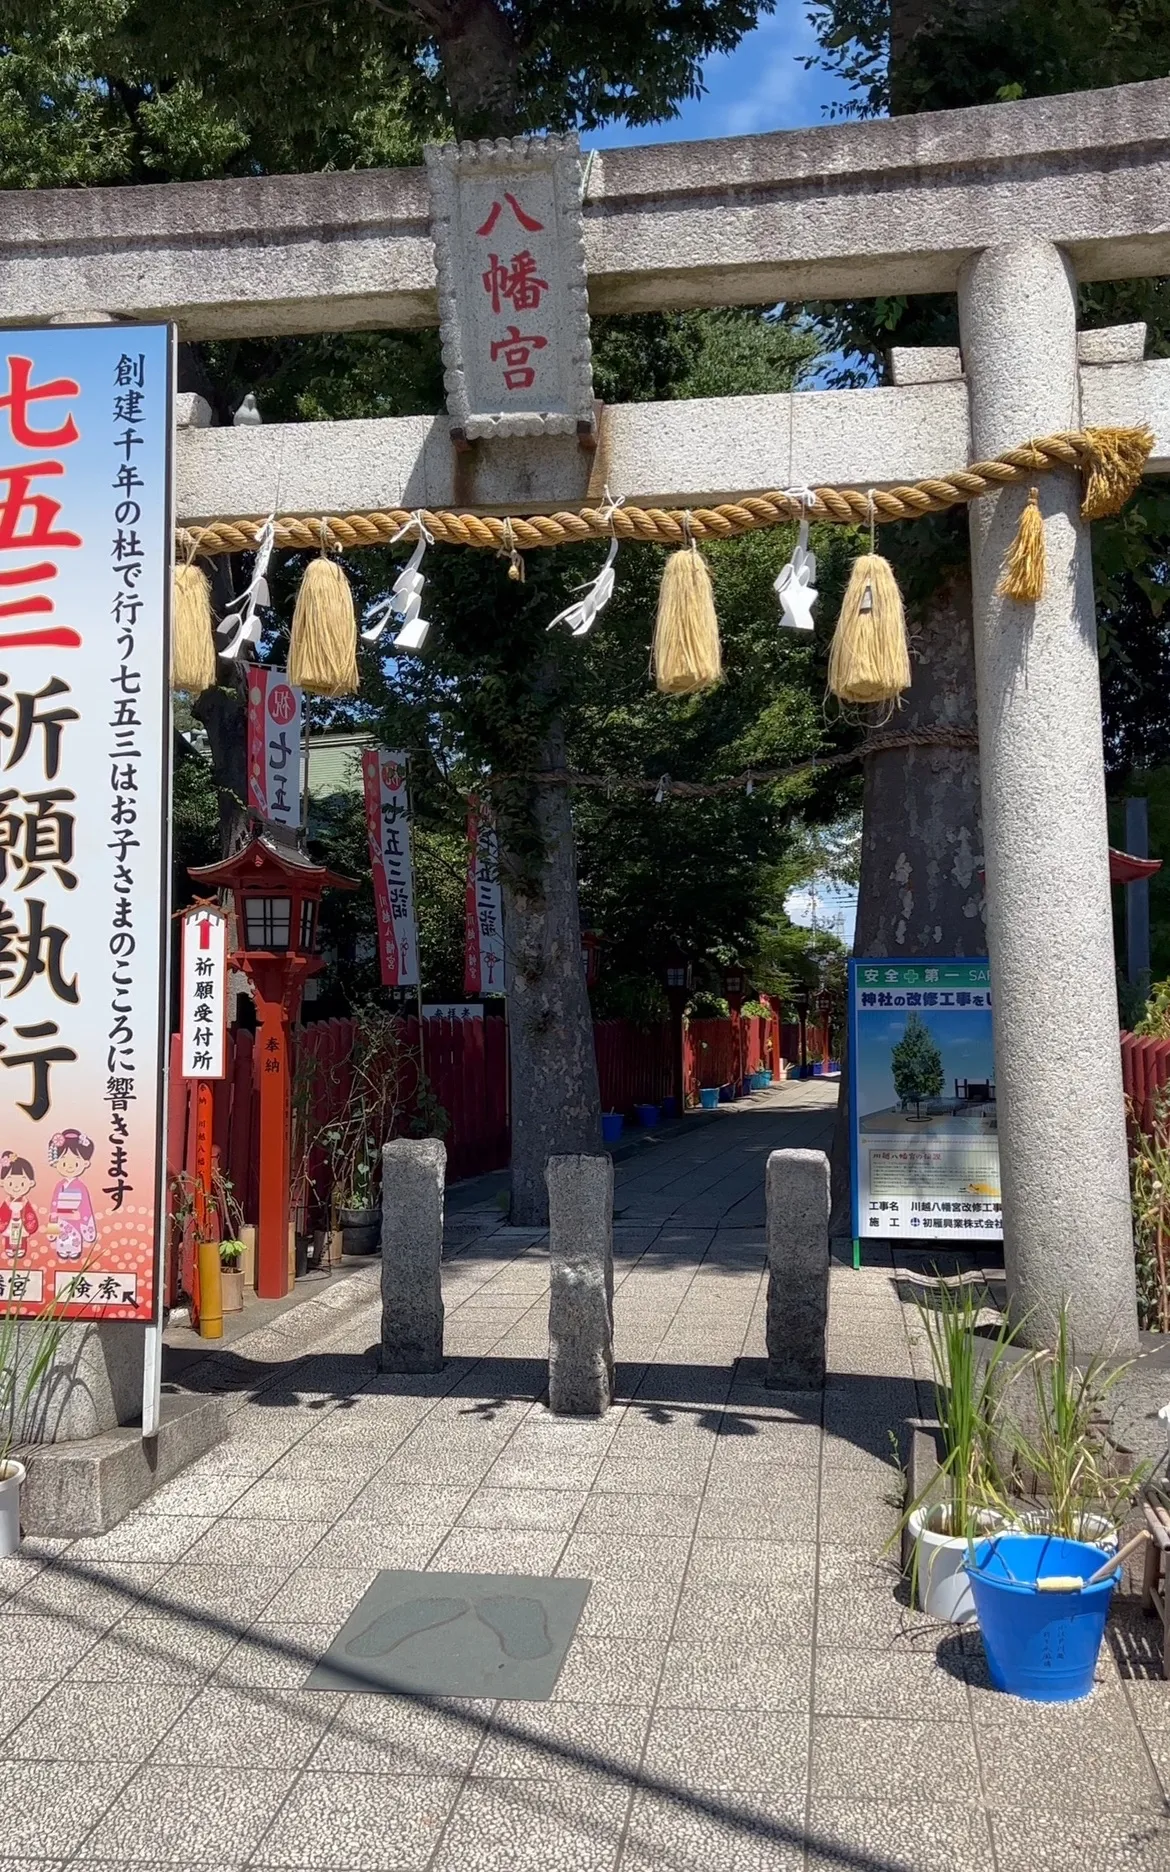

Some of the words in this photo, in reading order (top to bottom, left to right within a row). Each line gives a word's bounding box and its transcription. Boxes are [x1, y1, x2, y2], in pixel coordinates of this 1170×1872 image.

[476, 192, 549, 390] 八幡宮
[102, 353, 146, 1211] 創建千年の杜で行う七五三はお子さまのこころに響きます
[192, 957, 215, 1071] 祈願受付所
[265, 1037, 280, 1073] 奉納
[869, 1201, 899, 1211] 工事名
[71, 1276, 122, 1300] 検索
